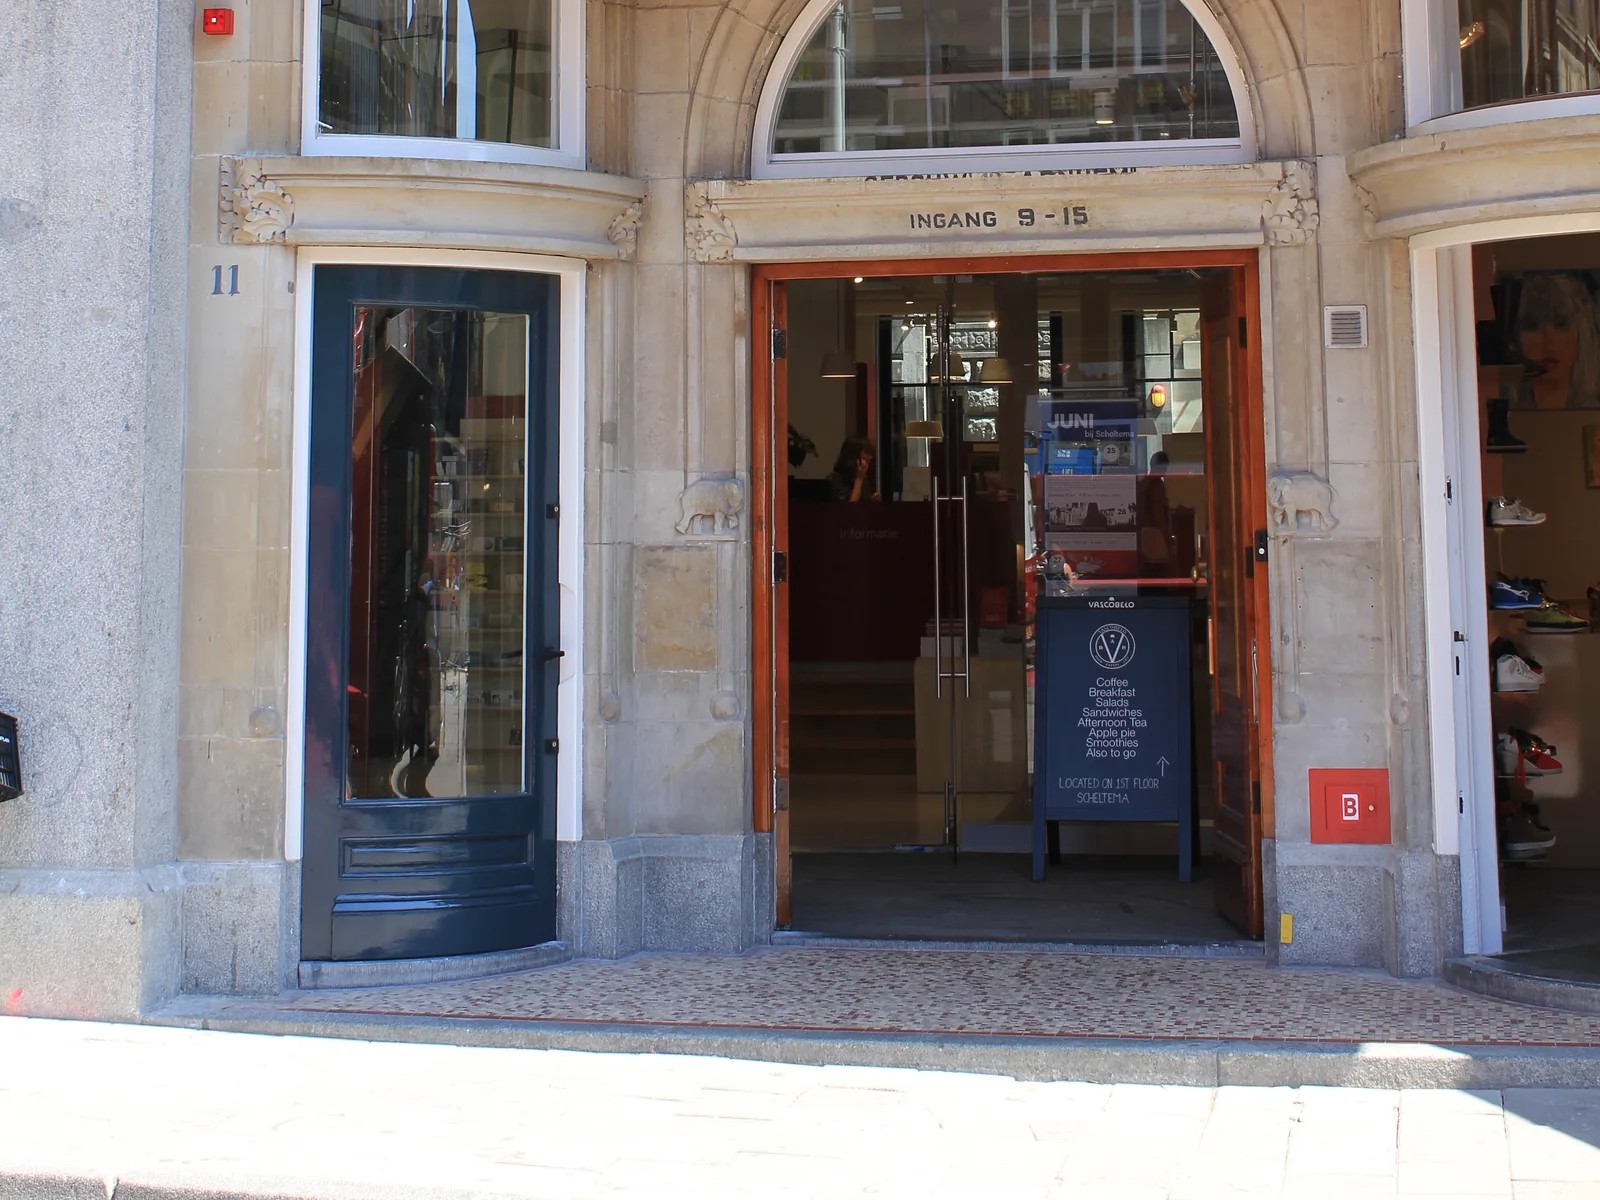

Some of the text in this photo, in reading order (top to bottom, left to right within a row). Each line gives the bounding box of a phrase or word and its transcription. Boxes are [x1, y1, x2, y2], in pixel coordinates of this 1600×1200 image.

[910, 211, 997, 229] INGANG
[211, 264, 241, 297] 11
[1047, 413, 1094, 429] JUNI
[1084, 429, 1135, 439] bij Scheltema
[1088, 601, 1135, 609] VASCOBELO
[1096, 677, 1129, 687] Coffee
[1088, 687, 1136, 697] Breakfast
[1095, 697, 1129, 707] Salads
[1082, 707, 1143, 717] Sandwiches
[1077, 717, 1148, 727] Afternoon Tea
[1088, 727, 1136, 739] Apple pie
[1085, 737, 1139, 747] Smoothies
[1085, 747, 1137, 760] Also to go
[1058, 777, 1160, 789] LOCATED ON 1ST FLOOR
[1077, 792, 1130, 803] SCHELTEMA
[1343, 797, 1357, 817] B
